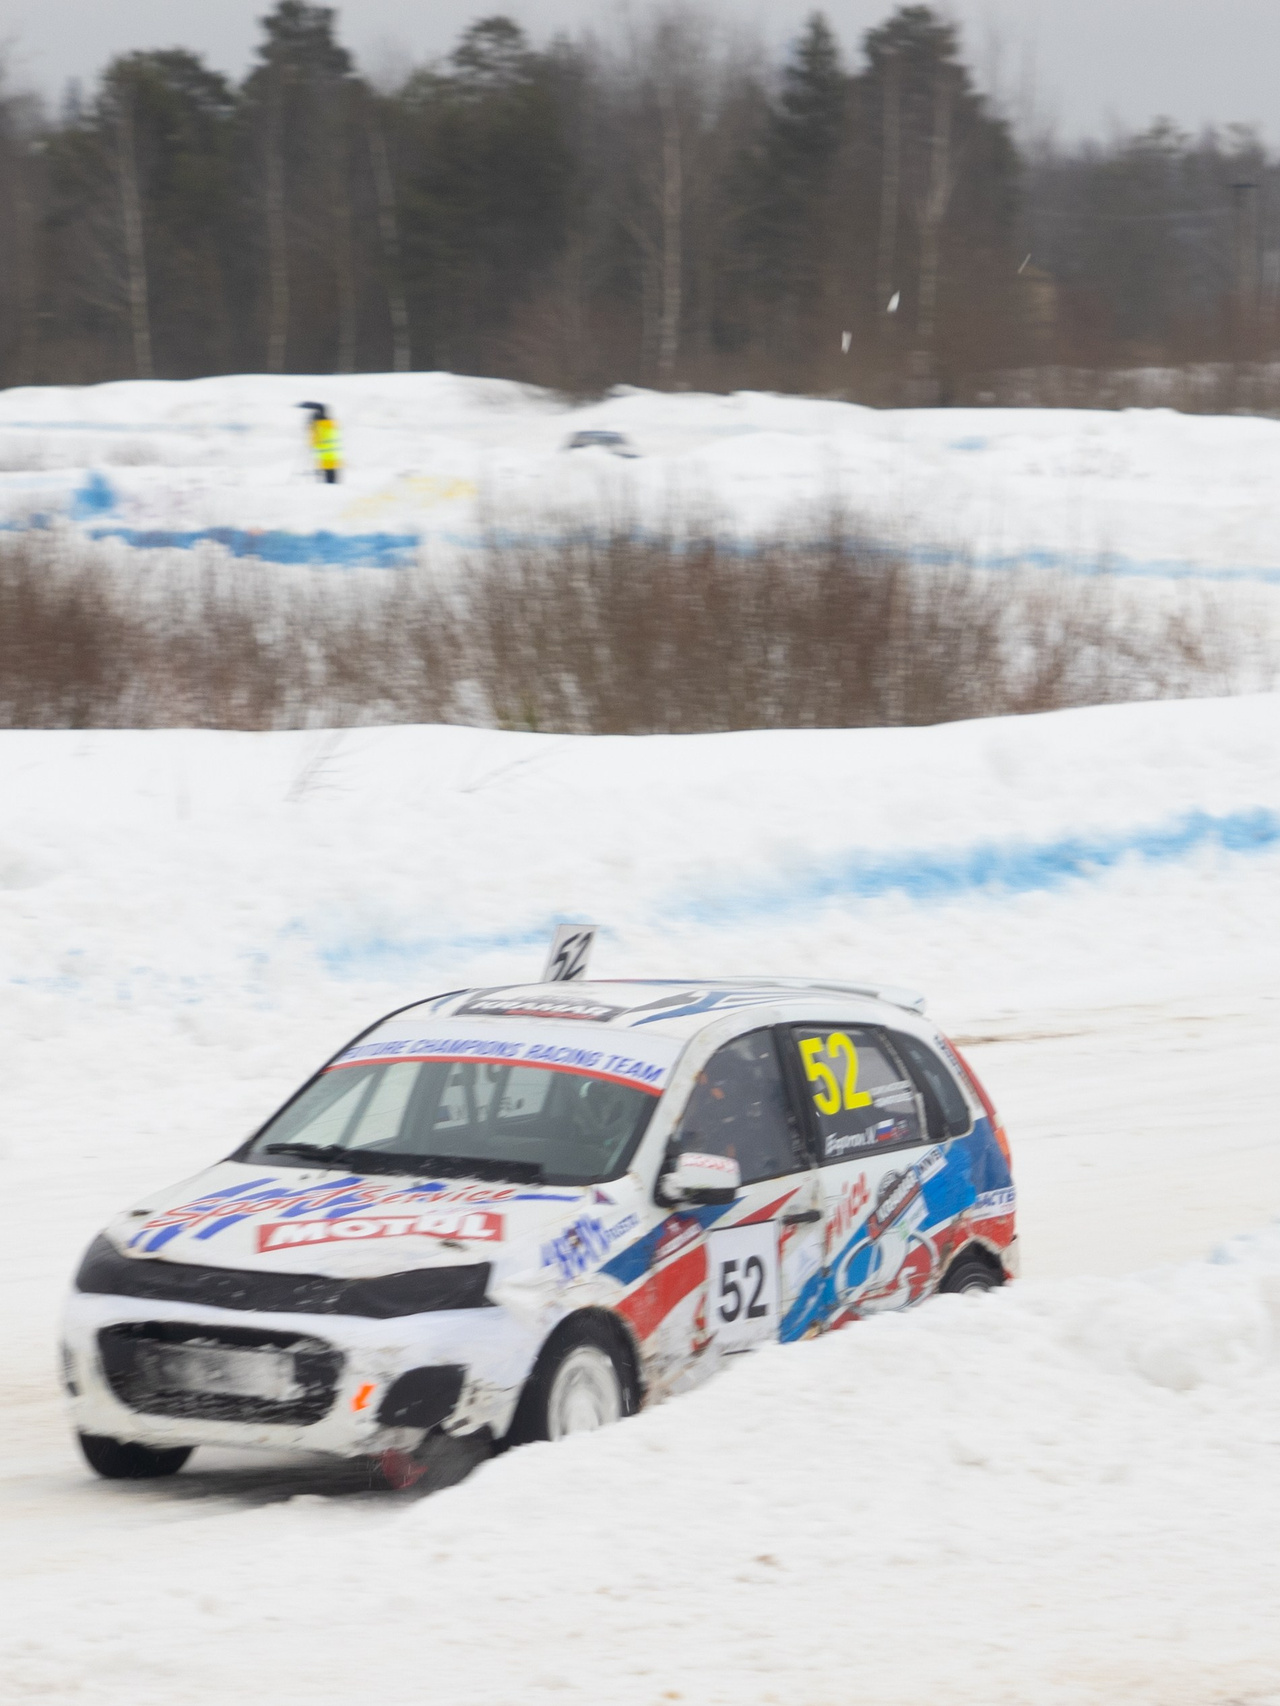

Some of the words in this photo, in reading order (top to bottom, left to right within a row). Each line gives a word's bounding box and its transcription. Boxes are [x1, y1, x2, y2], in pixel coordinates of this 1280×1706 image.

[551, 931, 595, 982] 52
[406, 1038, 525, 1058] CHAMPIONS
[523, 1043, 604, 1067] RACING
[602, 1054, 667, 1082] TEAM
[799, 1031, 873, 1117] 52
[265, 1213, 497, 1246] MOTUL
[718, 1256, 769, 1323] 52
